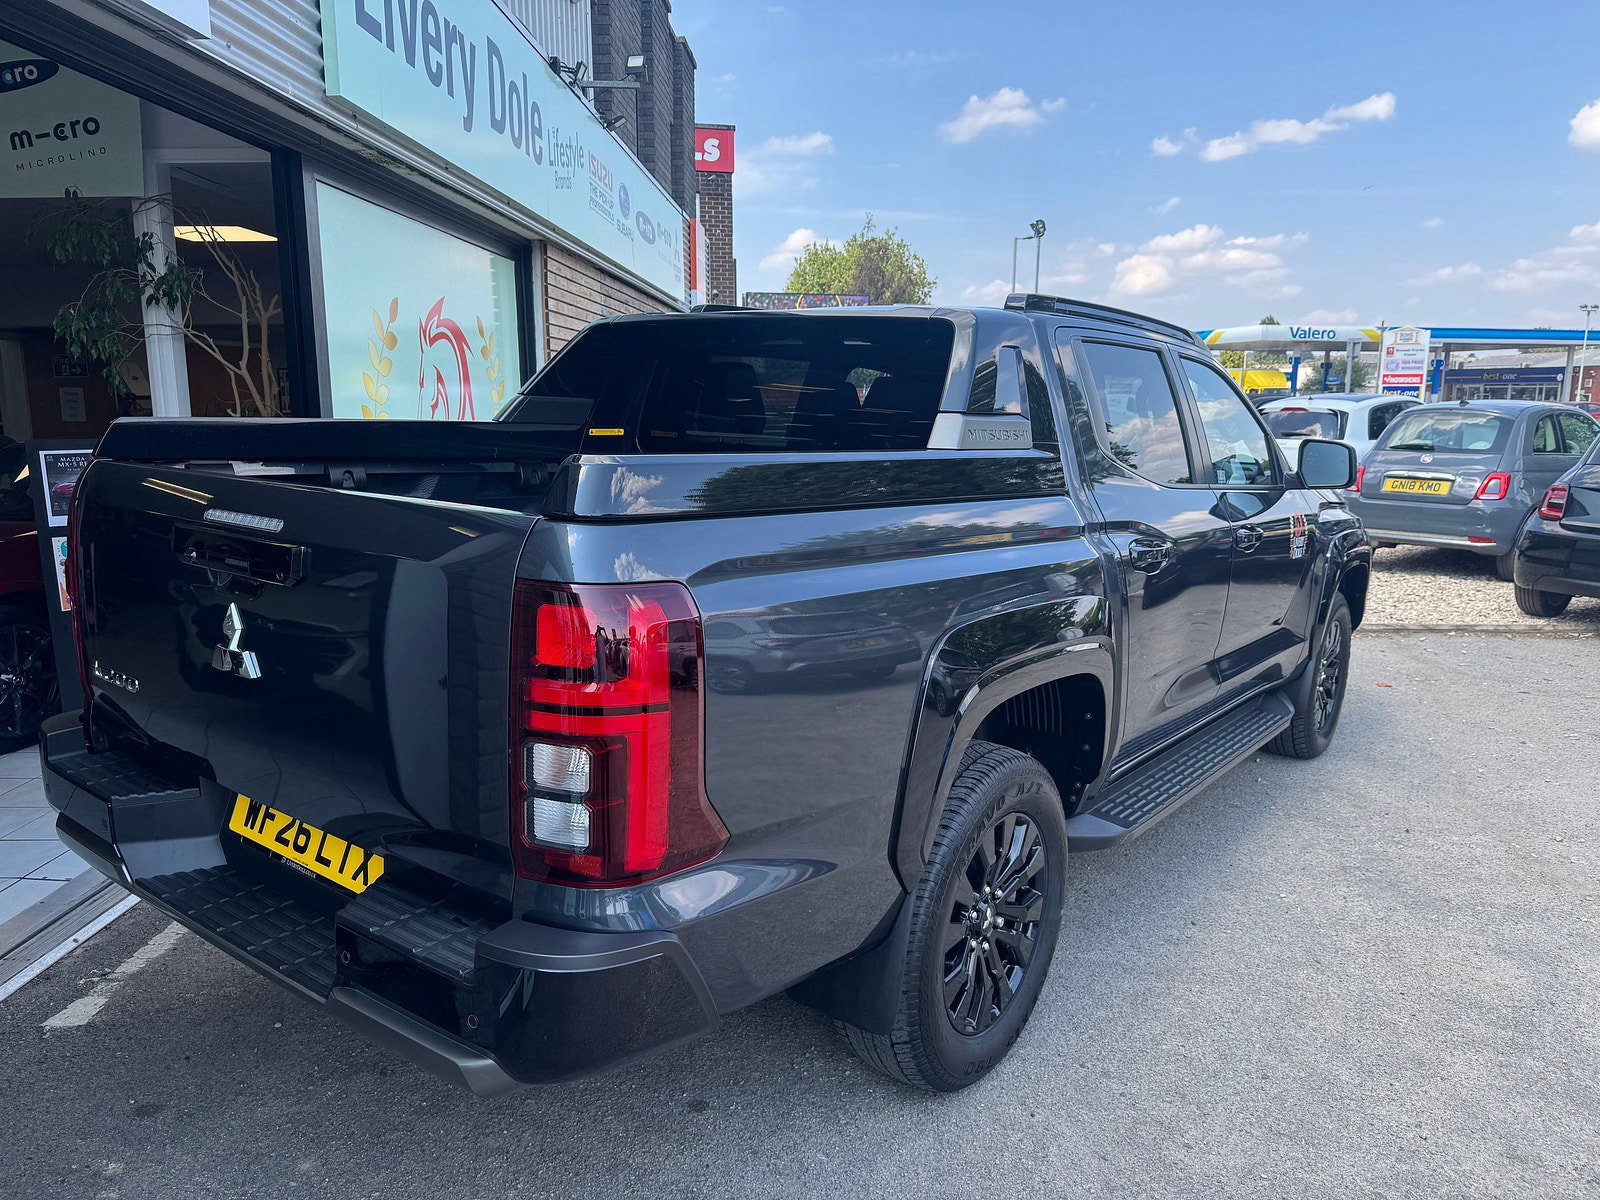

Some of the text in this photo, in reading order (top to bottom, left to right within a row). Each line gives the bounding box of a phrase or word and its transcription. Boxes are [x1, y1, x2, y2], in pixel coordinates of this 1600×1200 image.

[486, 35, 543, 166] Dole
[16, 146, 107, 171] MICROLINO
[547, 126, 585, 178] Lifestyle
[554, 170, 572, 190] Brands
[588, 150, 614, 192] ISUZU
[1290, 327, 1336, 339] Valero
[967, 428, 1031, 441] MITSUBISHI
[1391, 480, 1417, 491] GN18
[243, 799, 312, 855] WF26
